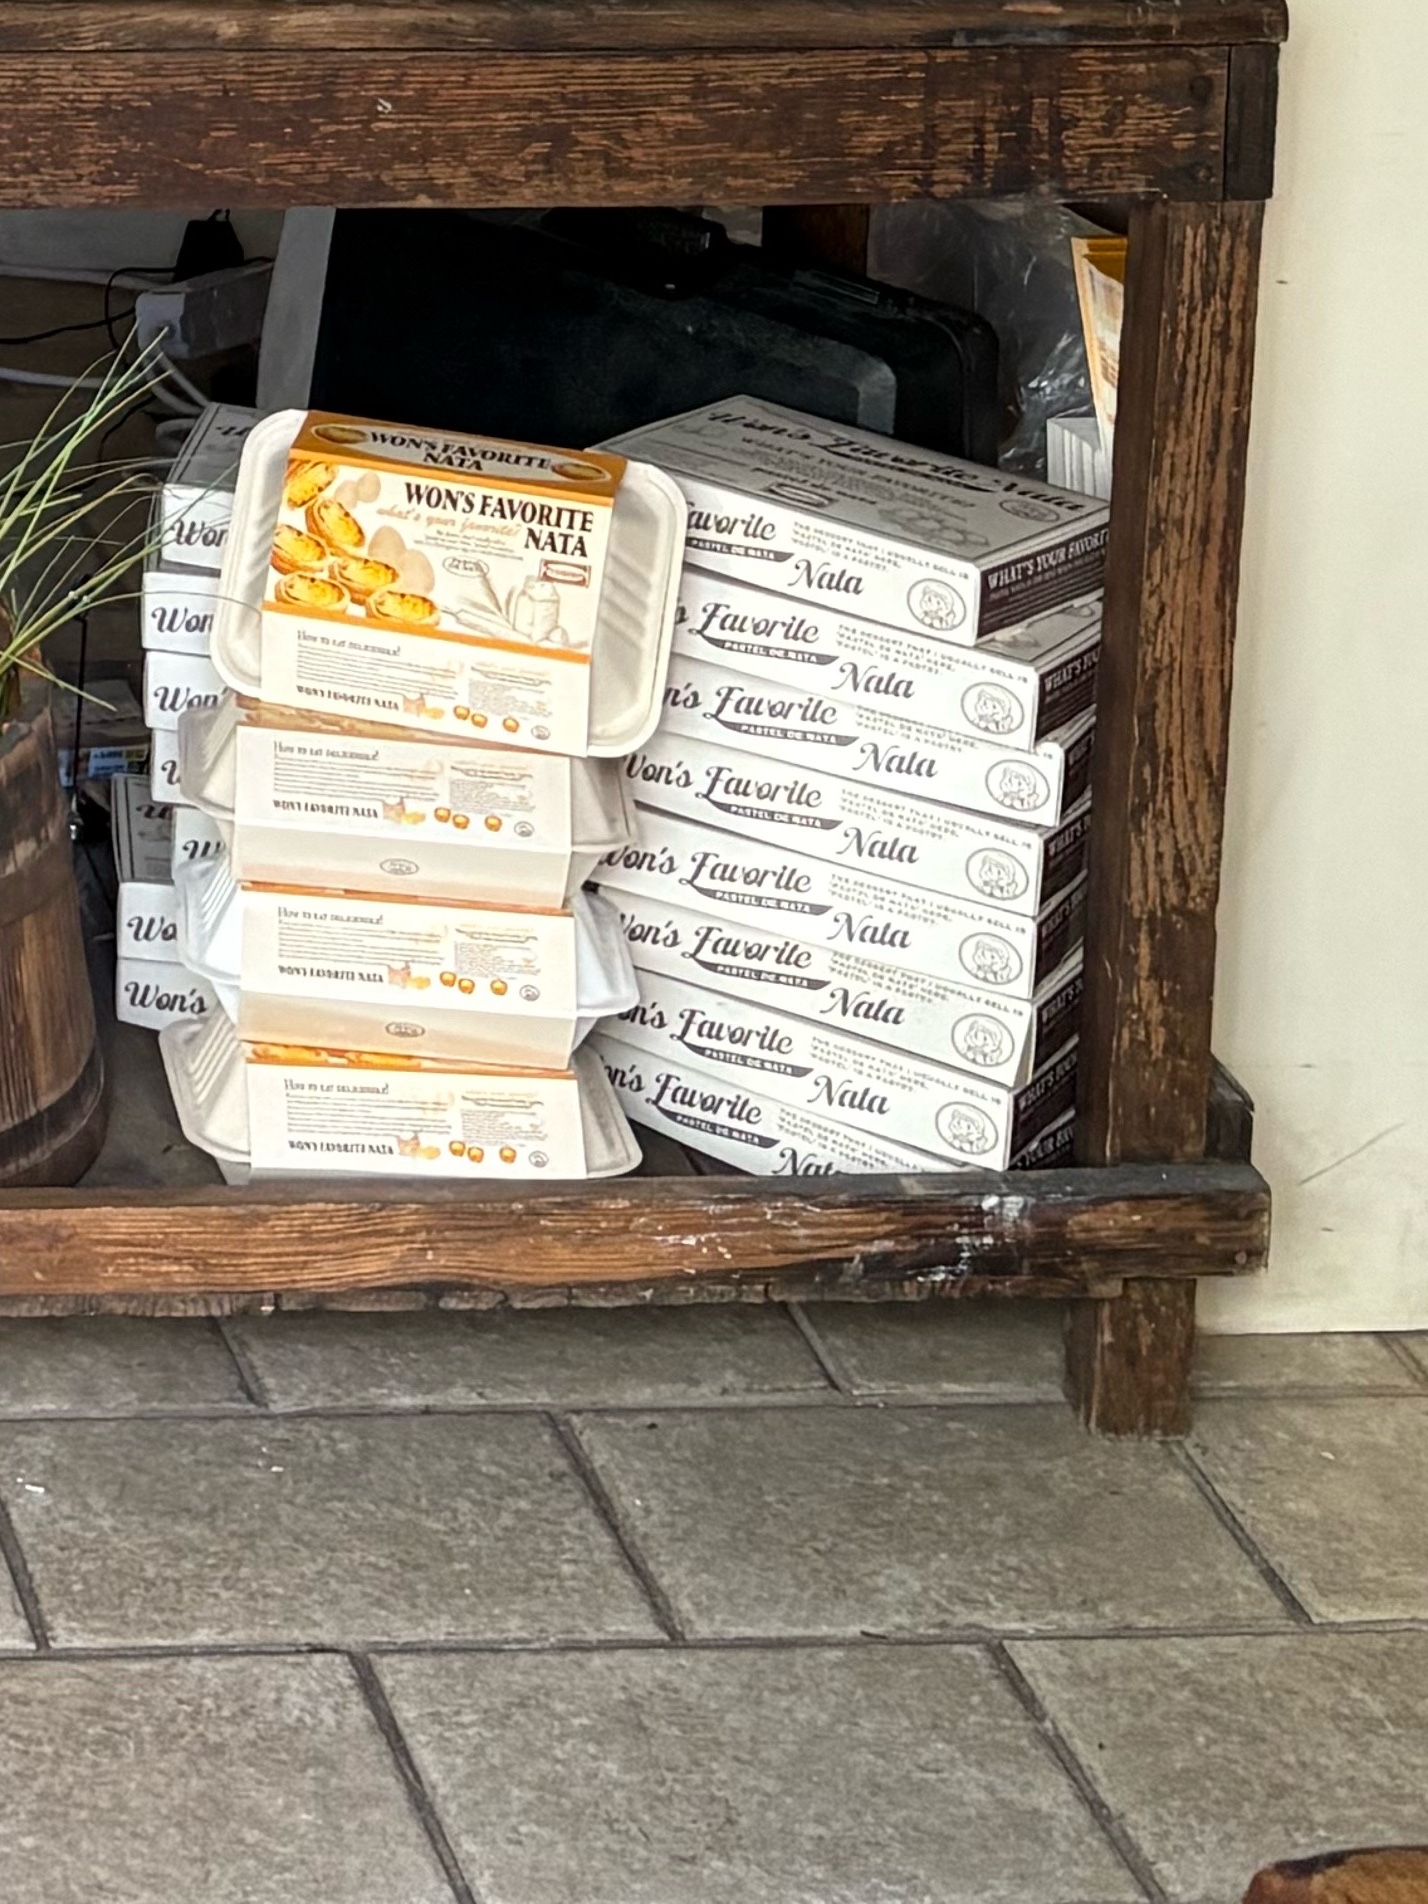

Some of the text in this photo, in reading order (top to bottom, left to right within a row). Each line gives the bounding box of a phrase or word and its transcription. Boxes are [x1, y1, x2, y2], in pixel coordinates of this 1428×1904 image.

[369, 429, 552, 472] WON'S FAVORITE
[422, 451, 484, 473] NATA
[405, 481, 594, 533] WON'S FAVORITE
[686, 501, 777, 541] avorite
[523, 527, 589, 559] NATA
[787, 557, 865, 597] Nata
[687, 601, 820, 645] Favorite
[830, 661, 915, 700] Nata
[663, 681, 839, 727] n's Favorite
[852, 741, 939, 779] Nata
[694, 764, 824, 809] Favorite
[835, 826, 921, 865] Nata
[677, 850, 813, 894] Favorite
[681, 925, 814, 971] Favorite
[826, 911, 913, 951] Nata
[124, 981, 209, 1015] Won's
[819, 987, 906, 1027] Nata
[669, 1007, 795, 1055] Favorite
[644, 1071, 763, 1126] Favorite
[806, 1074, 891, 1117] Nata
